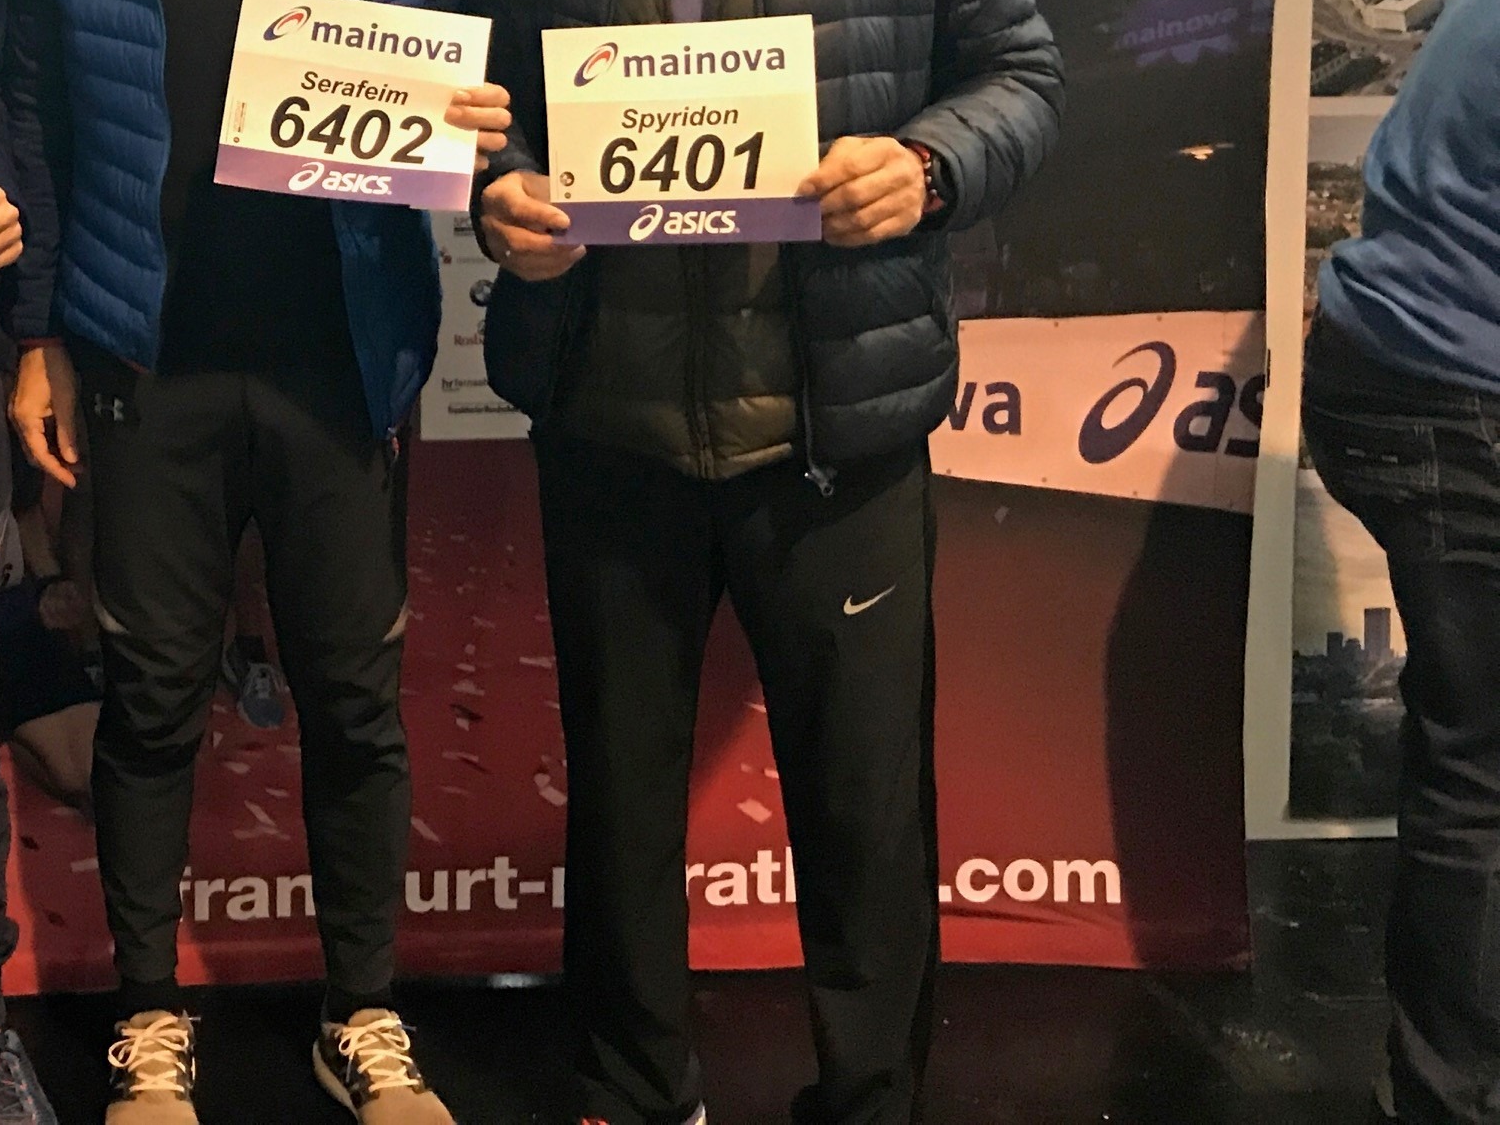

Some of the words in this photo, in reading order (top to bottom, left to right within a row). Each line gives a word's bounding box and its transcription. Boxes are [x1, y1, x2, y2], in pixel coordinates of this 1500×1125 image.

[311, 20, 463, 64] mainova
[623, 45, 785, 78] mainova
[300, 71, 409, 106] Serafeim
[270, 96, 433, 165] 6402
[621, 106, 739, 133] Spyridon
[599, 131, 765, 194] 6401
[321, 169, 392, 196] asics
[663, 210, 737, 235] asics
